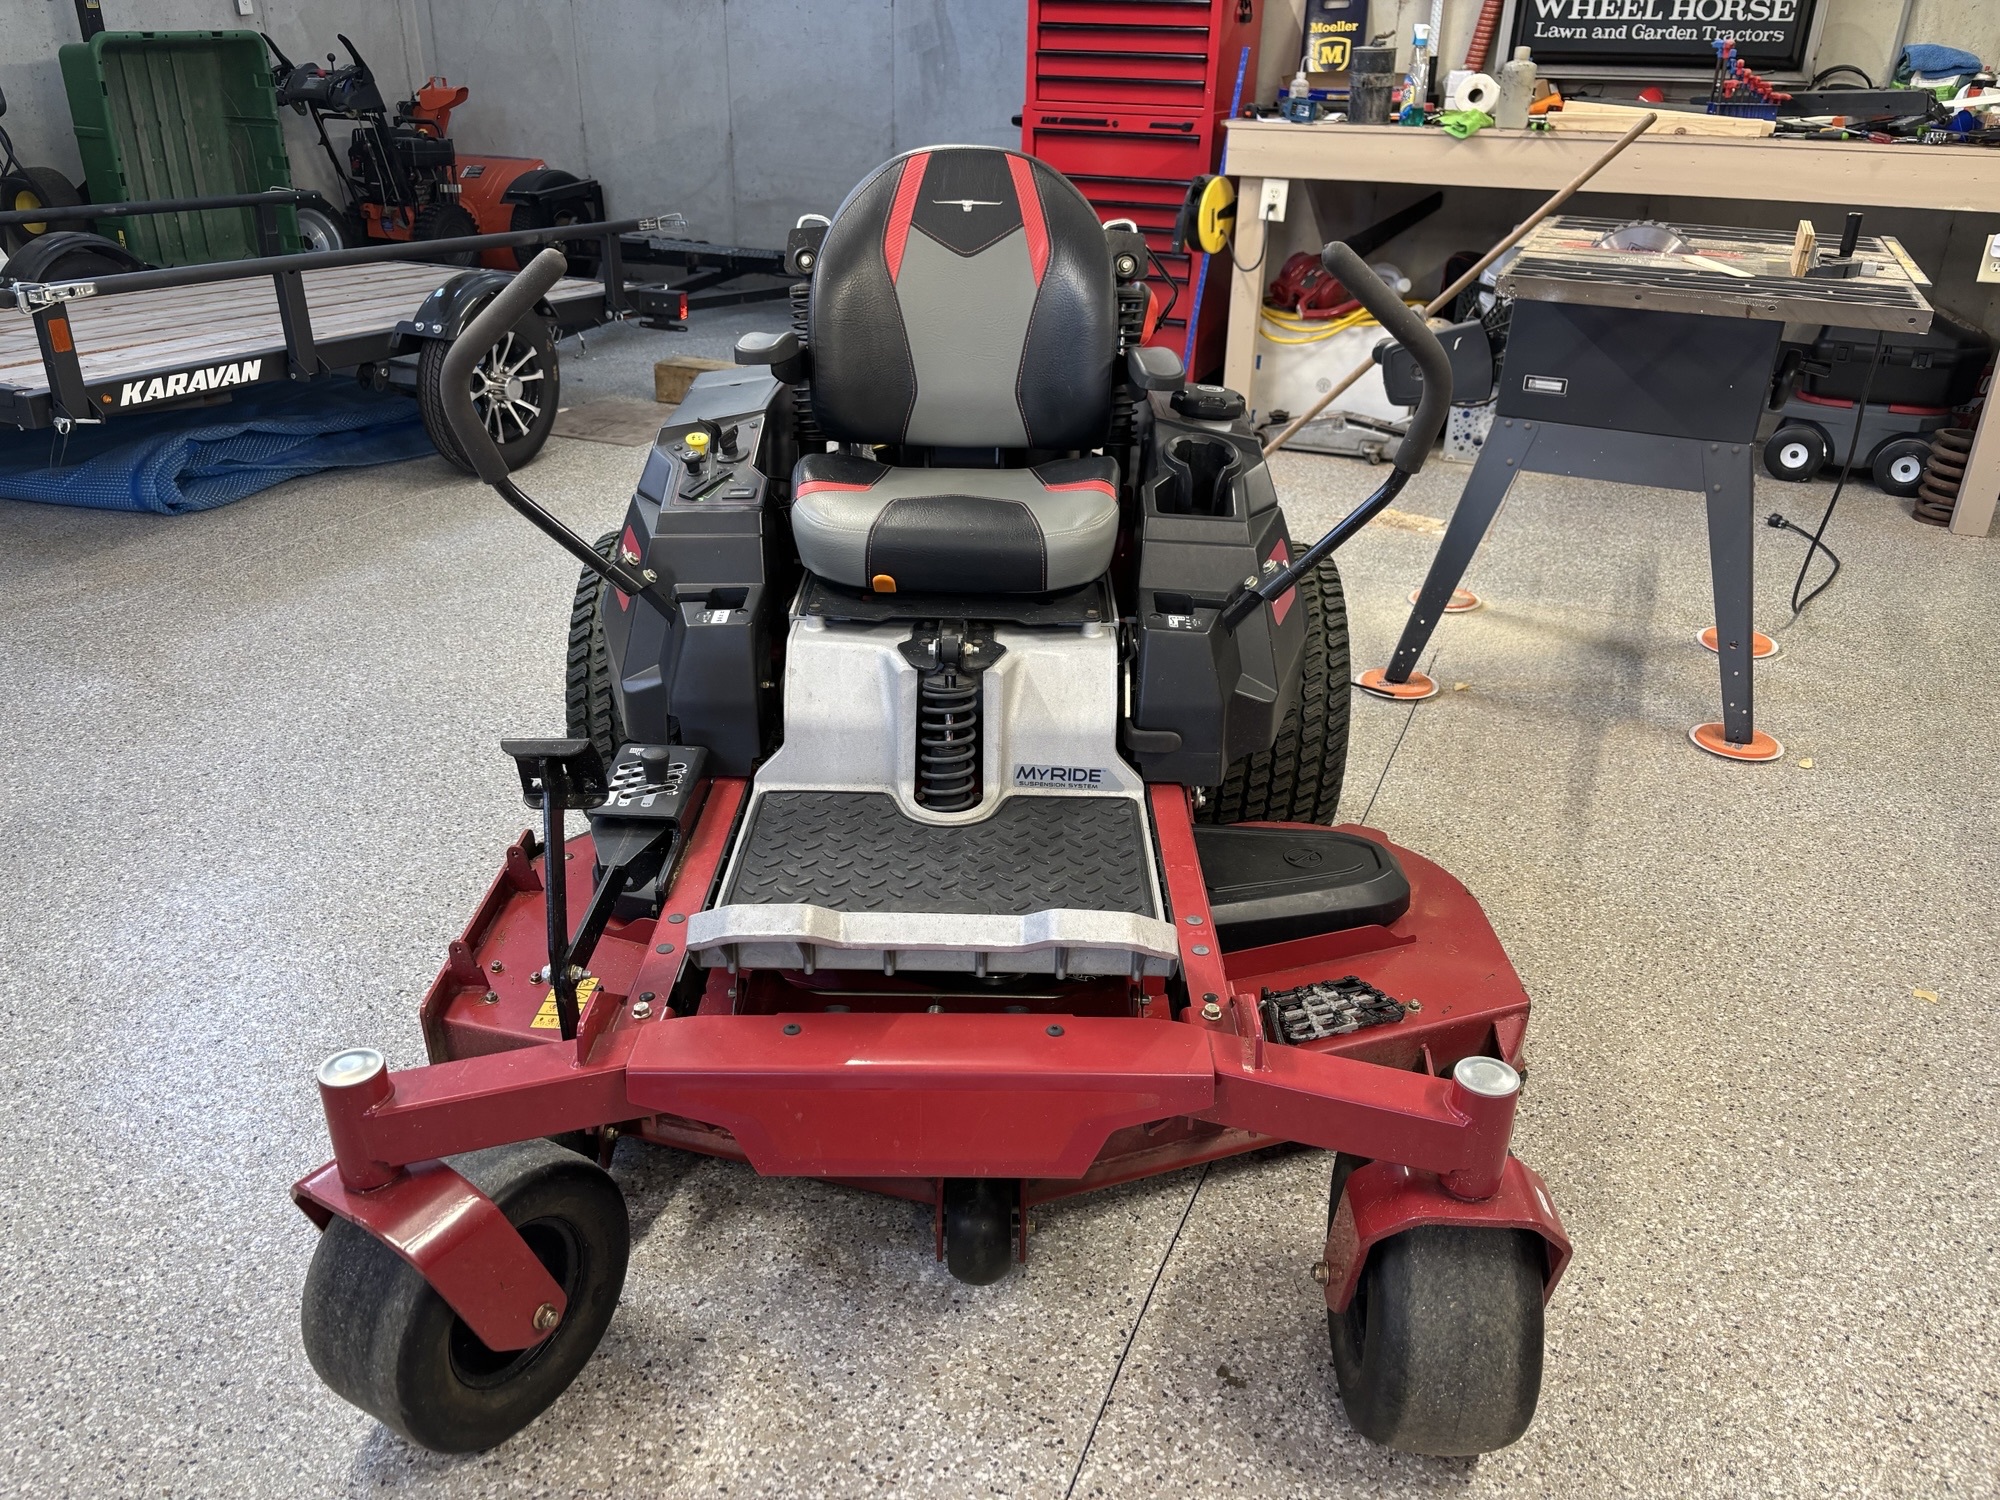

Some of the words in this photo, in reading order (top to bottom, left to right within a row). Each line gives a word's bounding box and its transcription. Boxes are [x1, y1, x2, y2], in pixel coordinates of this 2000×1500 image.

[1535, 0, 1663, 21] WHEEL
[1669, 0, 1798, 23] HORSE
[1310, 20, 1359, 33] Moeller
[1534, 22, 1588, 40] Lawn
[1591, 23, 1627, 40] and
[1631, 24, 1698, 41] Garden
[1702, 25, 1785, 43] Tractors
[1320, 45, 1344, 64] M
[120, 359, 262, 407] KARAVAN
